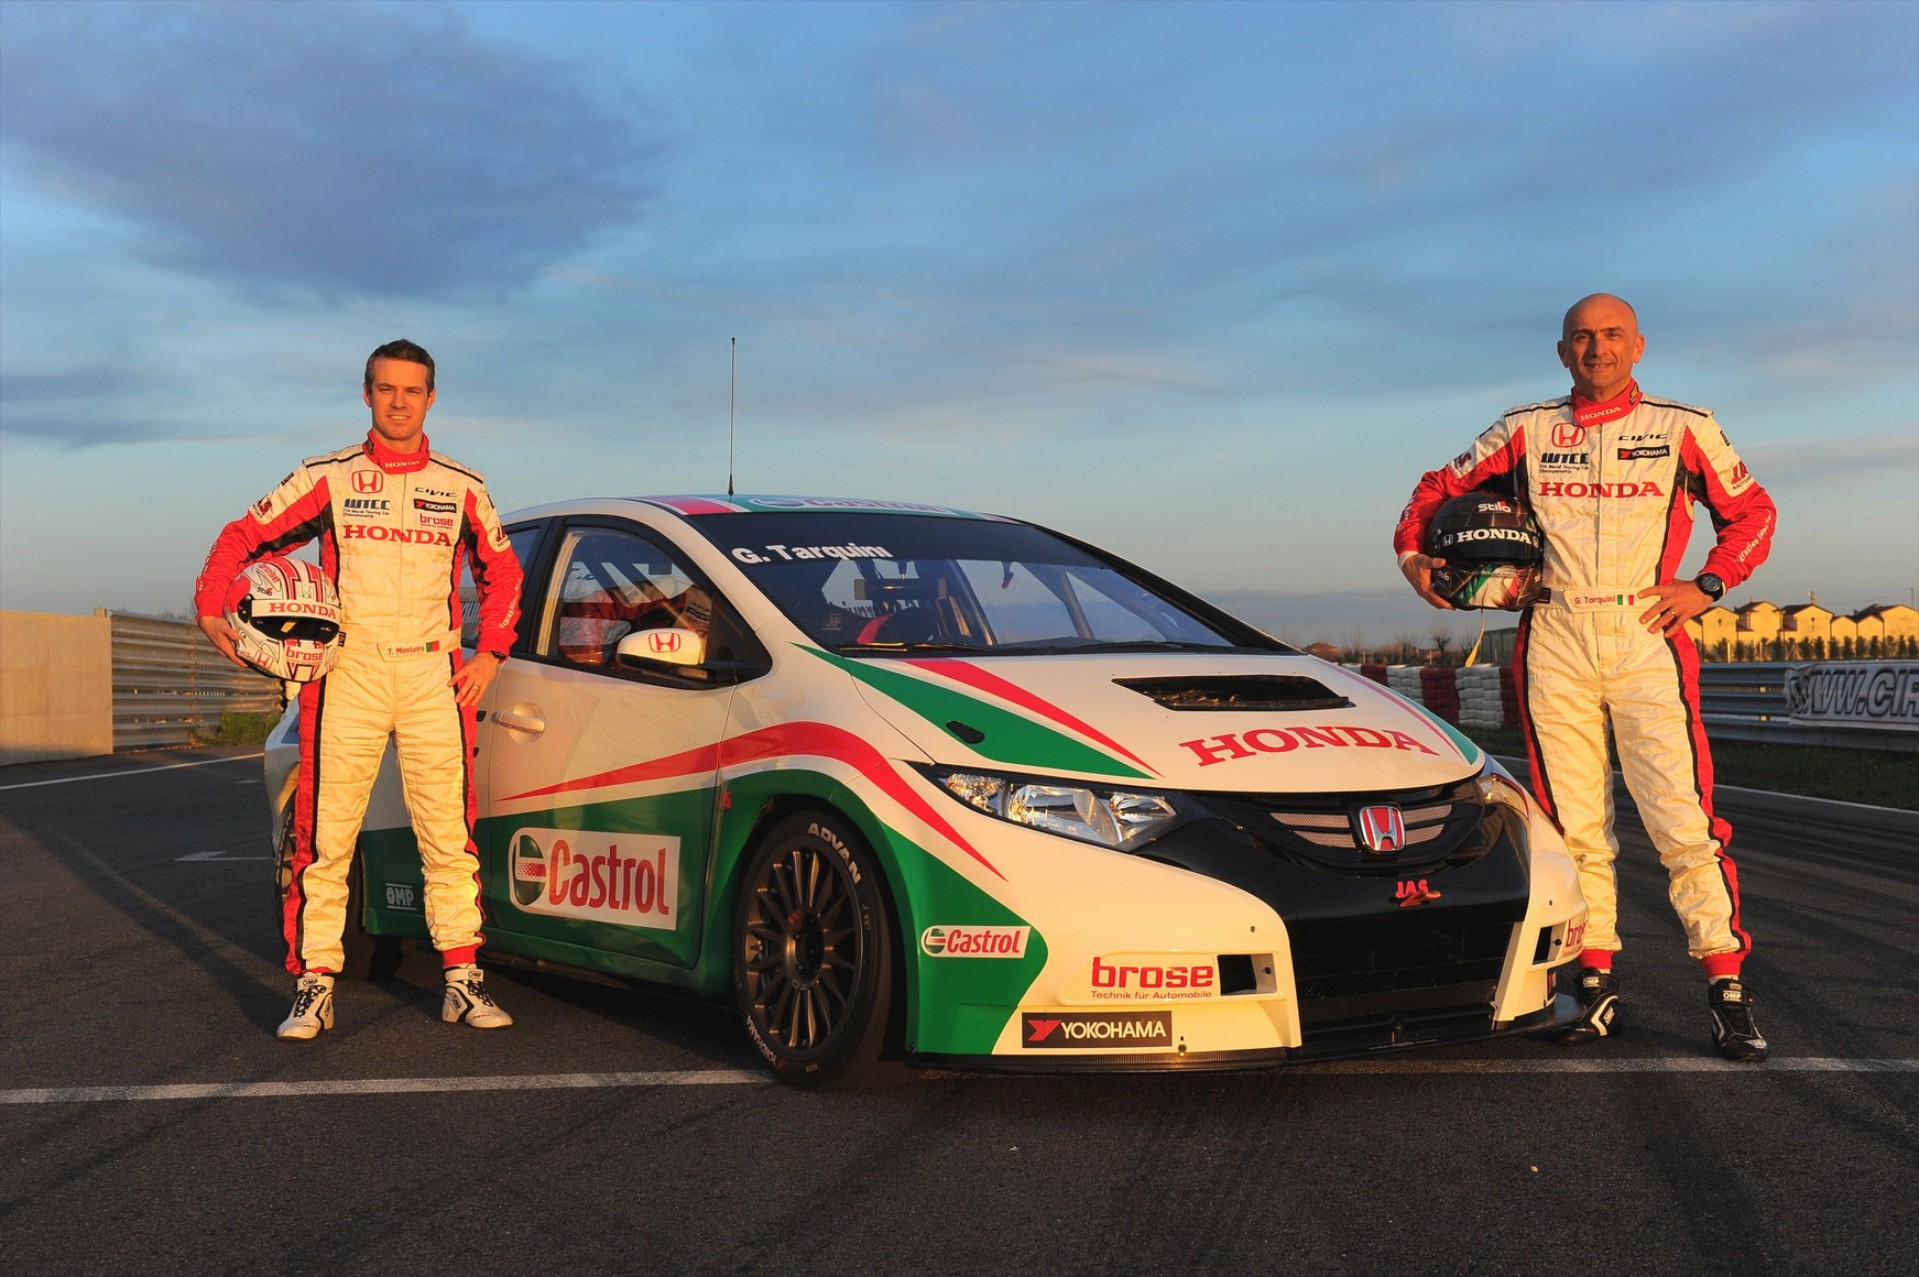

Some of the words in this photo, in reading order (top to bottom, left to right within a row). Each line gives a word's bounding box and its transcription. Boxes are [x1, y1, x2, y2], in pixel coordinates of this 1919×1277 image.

[1579, 407, 1621, 421] HONDA
[1618, 434, 1669, 442] CIVIC
[1631, 447, 1668, 458] YOKOHAMA
[415, 487, 457, 497] CIVIC
[1538, 482, 1664, 498] HONDA
[344, 498, 391, 510] WTCC
[1478, 500, 1511, 513] Stilo
[420, 513, 454, 526] brose
[343, 524, 452, 547] HONDA
[1457, 529, 1532, 545] HONDA
[731, 546, 771, 564] G.
[765, 542, 894, 561] Tarquini
[1584, 595, 1616, 605] Tarquini
[269, 602, 337, 619] HONDA
[285, 645, 324, 661] brose
[1178, 726, 1441, 767] HONDA
[807, 822, 862, 885] ADVAN
[548, 839, 669, 916] Castrol
[386, 886, 415, 907] OMP
[1395, 879, 1429, 899] JAS
[946, 929, 1021, 954] Castrol
[1091, 957, 1213, 988] brose
[1091, 990, 1131, 1000] Technik
[1134, 991, 1149, 1000] für
[1153, 990, 1212, 1000] Automobile
[1061, 1021, 1166, 1039] YOKOHAMA
